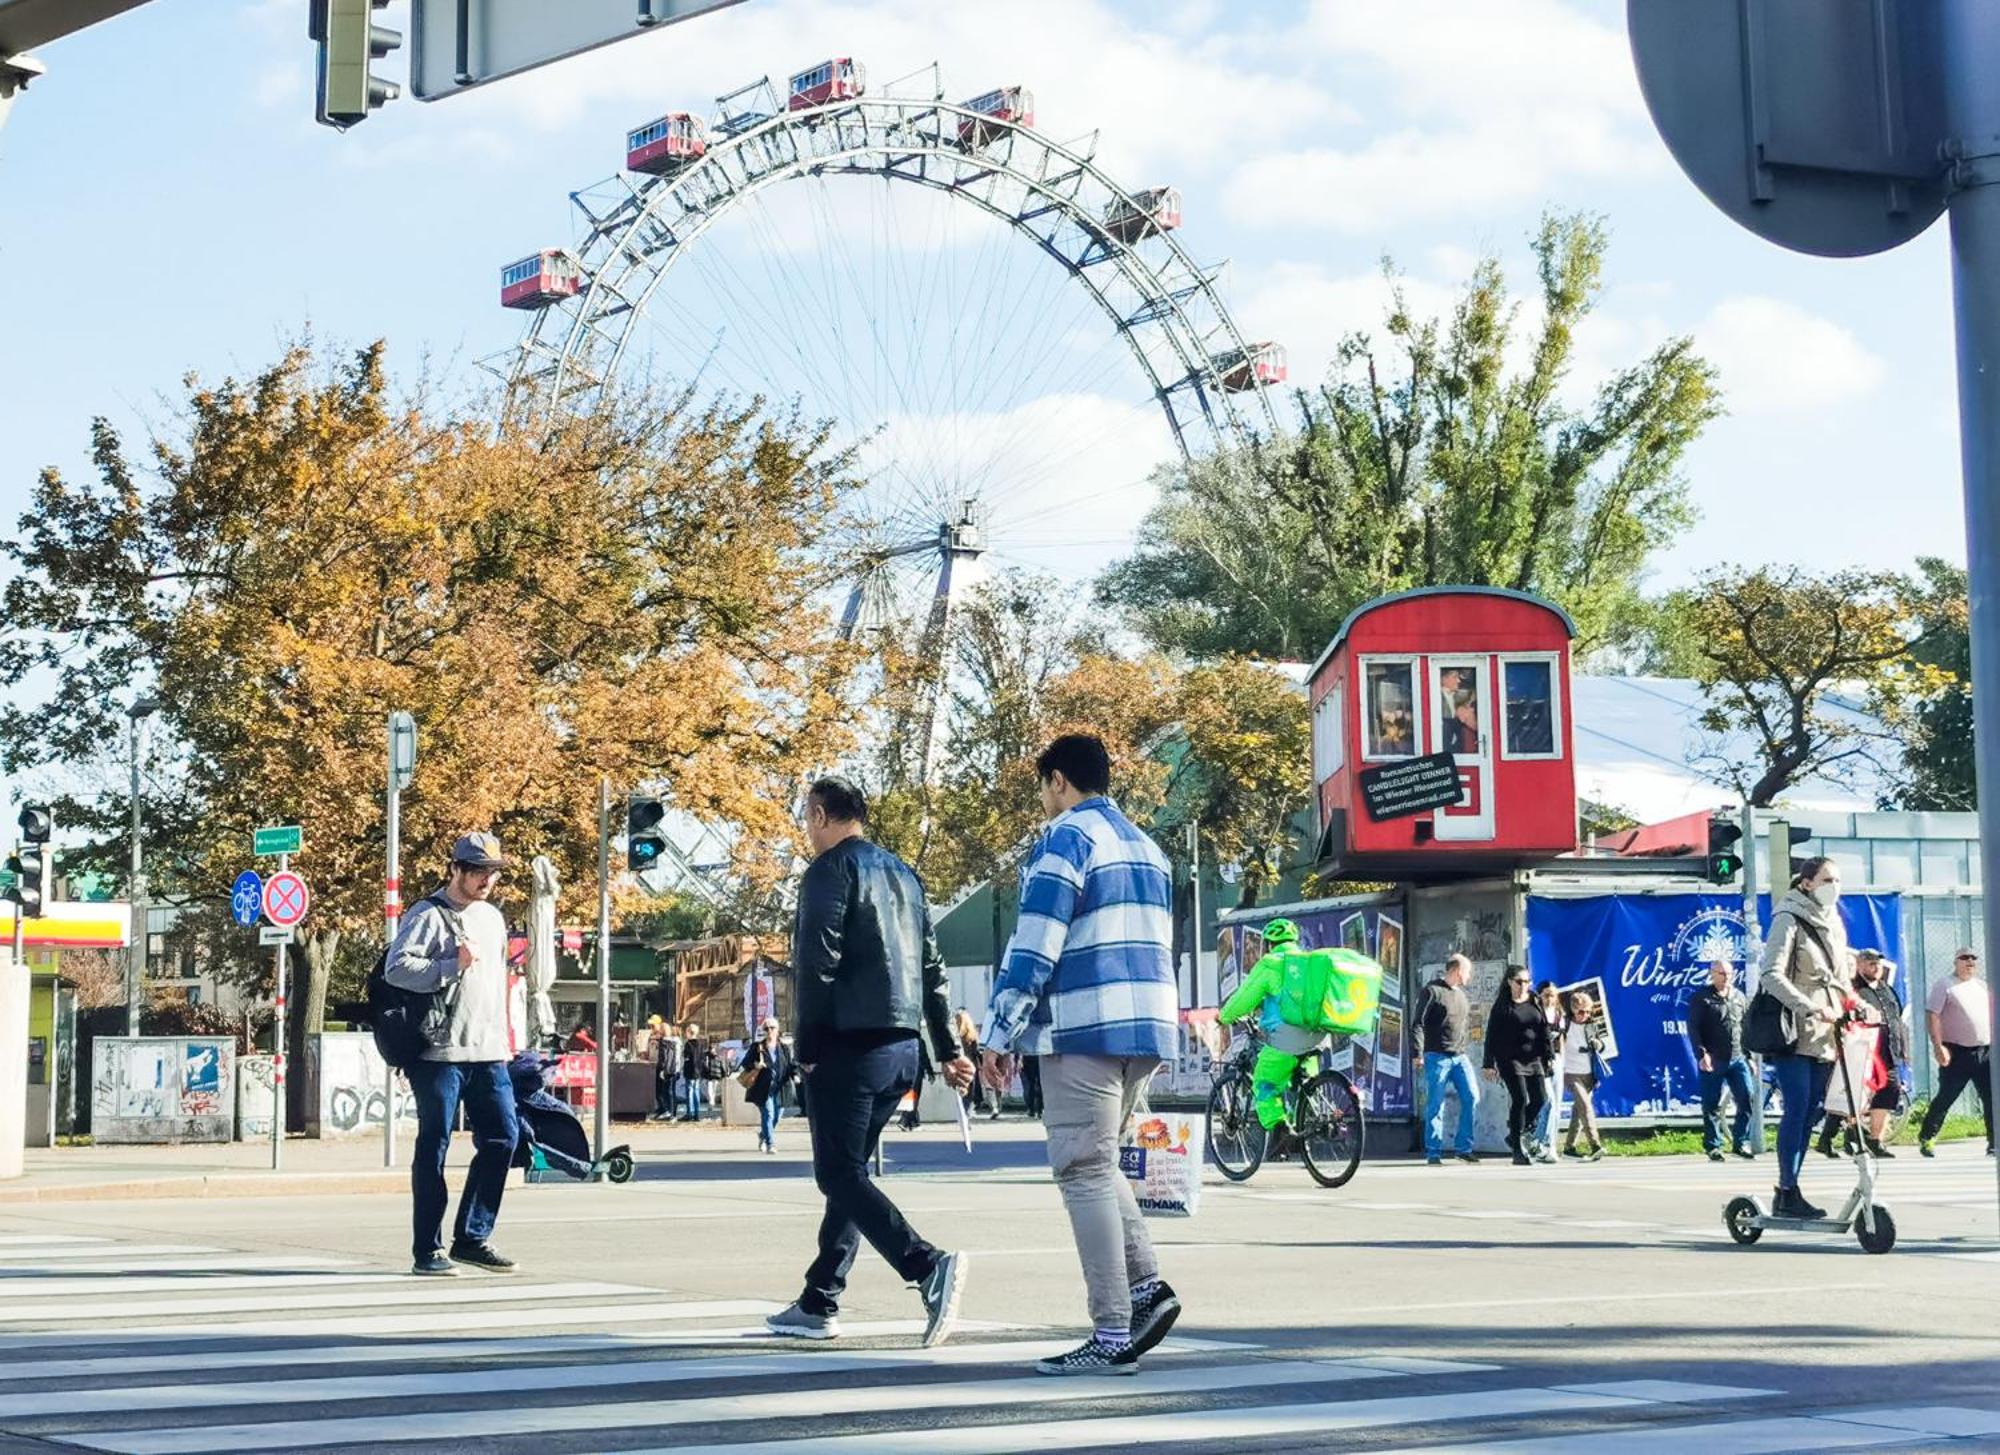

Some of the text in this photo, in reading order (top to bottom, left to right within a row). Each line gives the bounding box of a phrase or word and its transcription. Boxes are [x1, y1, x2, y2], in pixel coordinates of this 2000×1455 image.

[1367, 766, 1452, 793] CANDLELIGHT DINNER
[1380, 761, 1434, 779] Romantisches
[1385, 786, 1412, 800] Wiener
[1413, 777, 1452, 792] Riesenrad
[1375, 790, 1456, 815] wienerriesenrad.com
